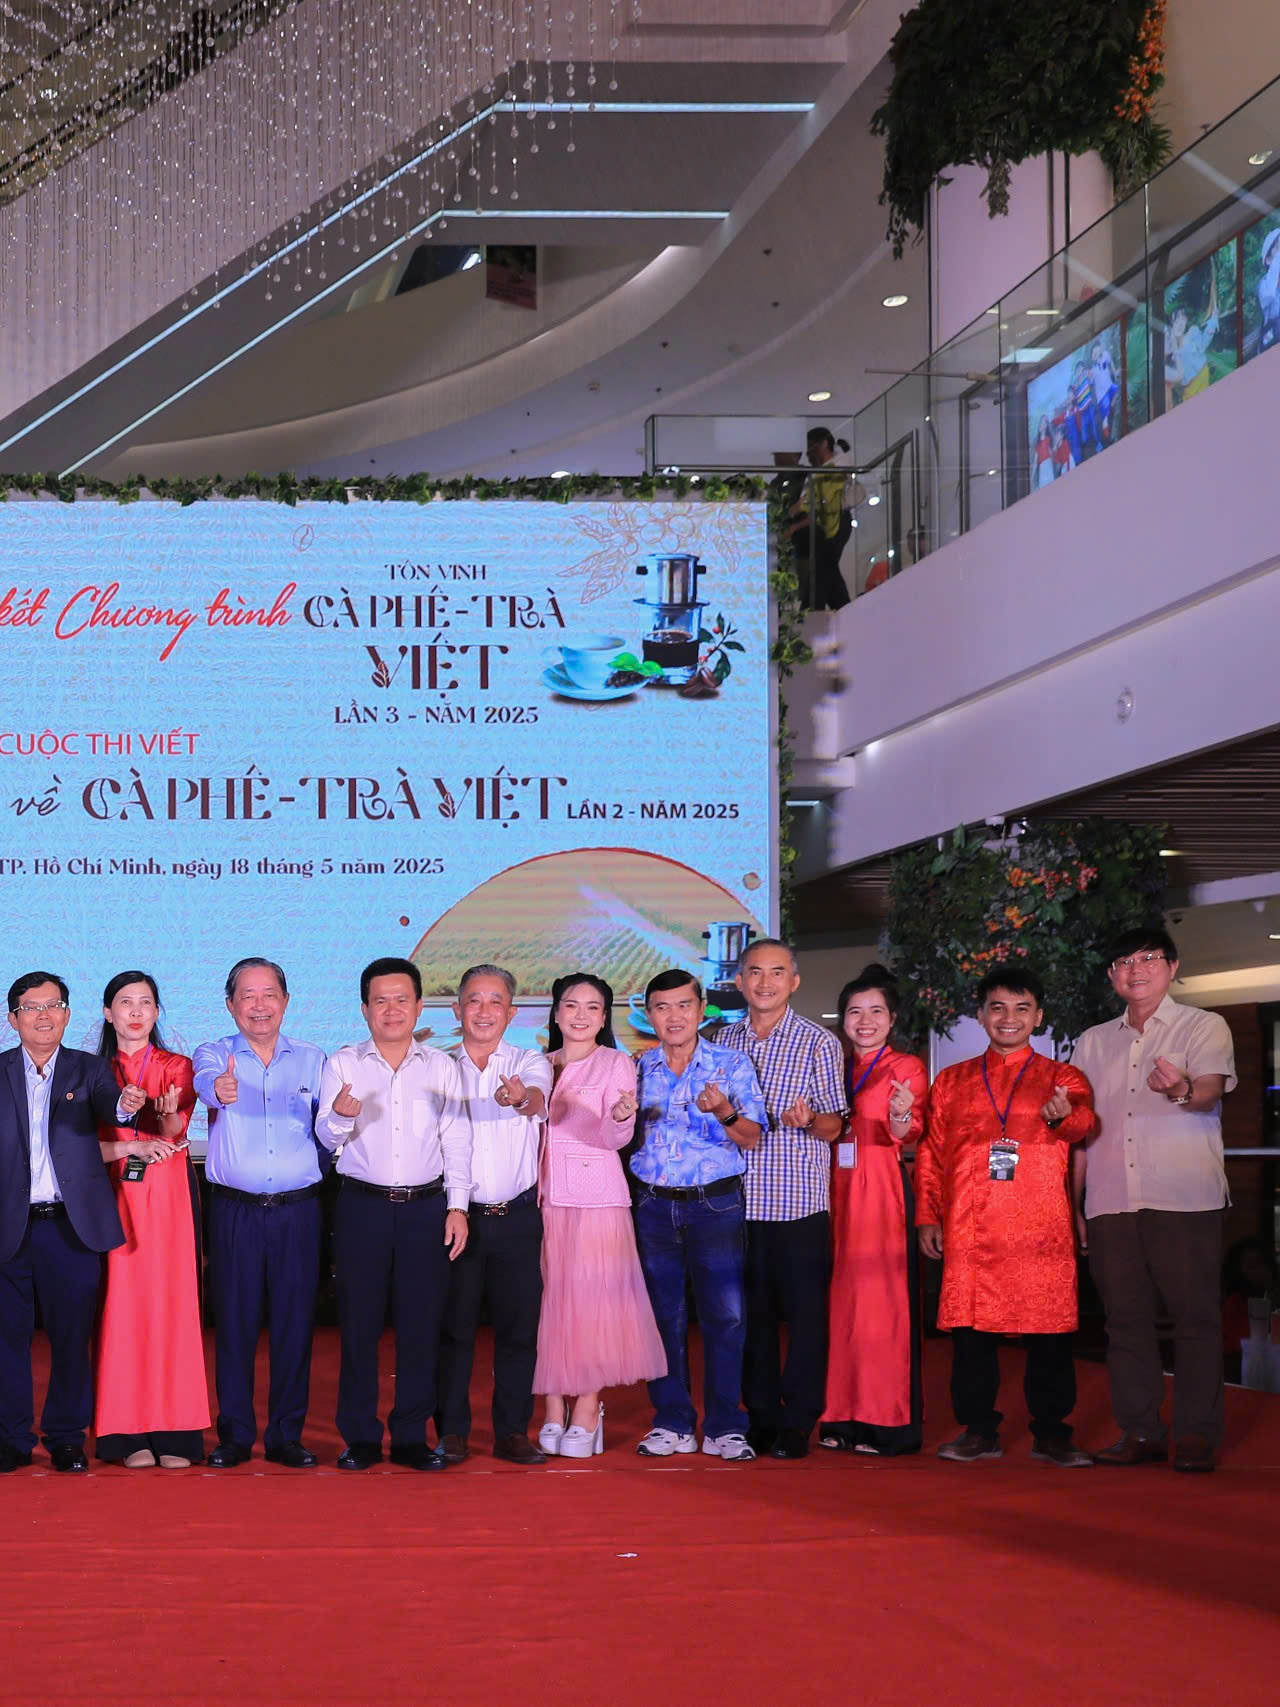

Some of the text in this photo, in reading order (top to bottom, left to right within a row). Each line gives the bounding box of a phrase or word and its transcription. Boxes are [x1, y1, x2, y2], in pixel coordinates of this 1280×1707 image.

[384, 559, 487, 581] TÔN VINH
[55, 582, 199, 662] Chương
[204, 581, 297, 628] trình
[303, 587, 360, 629] CÀ
[364, 632, 509, 699] VIỆT
[333, 700, 380, 724] LẦN
[385, 706, 399, 724] 3
[425, 701, 476, 724] NĂM
[483, 706, 540, 724] 2025
[85, 733, 132, 756] THI
[138, 727, 201, 756] VIẾT
[9, 773, 66, 817] về
[82, 766, 155, 821] CÀ
[433, 765, 568, 828] VIỆT
[568, 798, 607, 820] LẦN
[612, 803, 624, 819] 2
[640, 800, 687, 819] NĂM
[692, 803, 740, 819] 2025
[33, 856, 61, 875] Hồ
[67, 856, 103, 875] Chí
[109, 856, 167, 876] Minh,
[172, 858, 222, 880] ngày
[229, 858, 250, 875] 18
[256, 856, 314, 878] tháng
[320, 858, 334, 874] 5
[341, 858, 386, 874] năm
[393, 858, 445, 875] 2025
